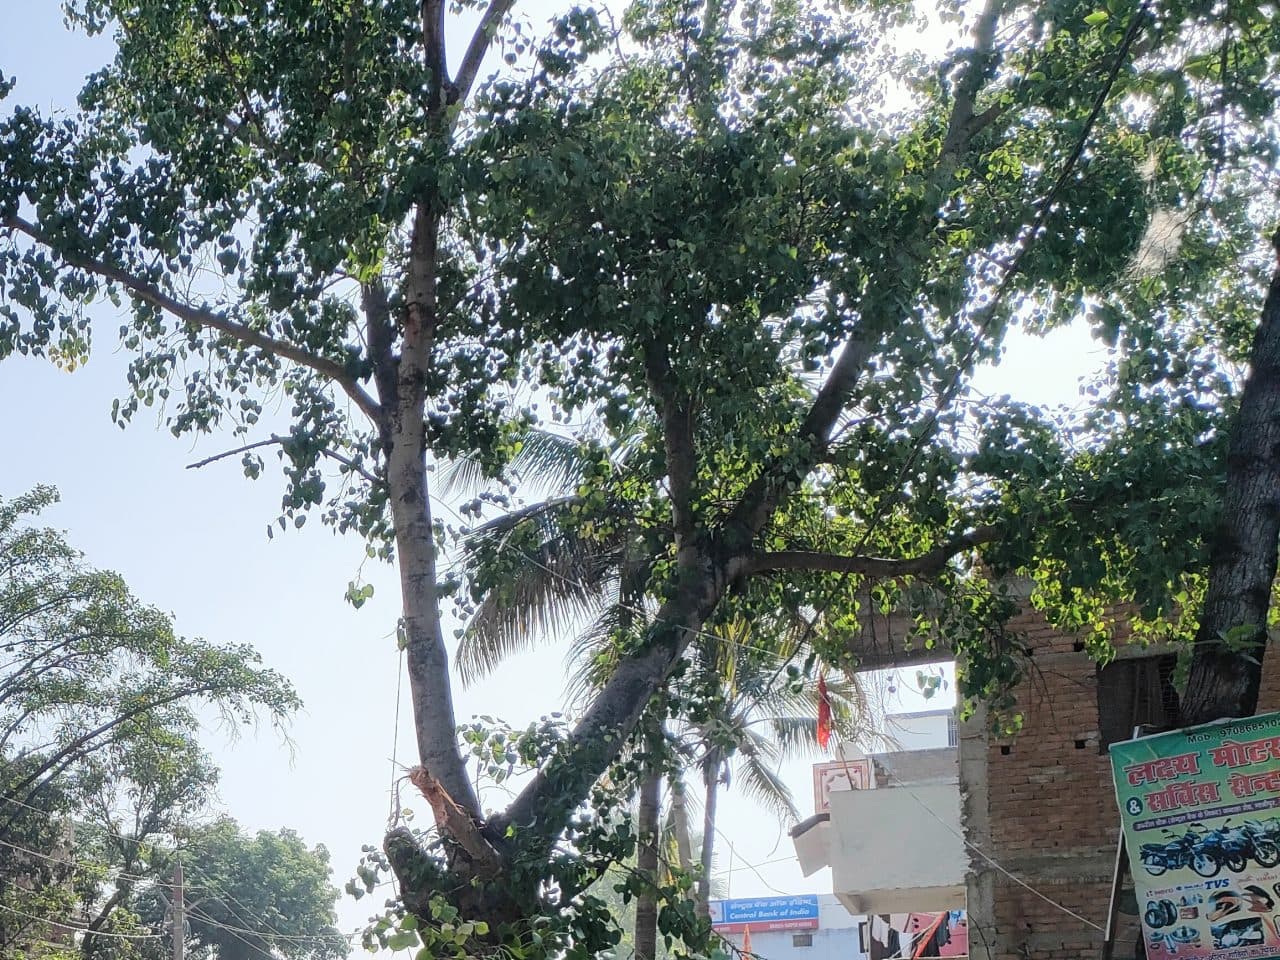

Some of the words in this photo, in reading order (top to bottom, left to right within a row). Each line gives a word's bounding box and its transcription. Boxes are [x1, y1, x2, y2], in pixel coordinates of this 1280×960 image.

[1220, 719, 1280, 738] 970868510
[1144, 780, 1221, 813] सर्विस
[1205, 878, 1230, 890] TVS
[730, 911, 757, 919] Central
[759, 909, 779, 918] Bank
[790, 906, 810, 915] India
